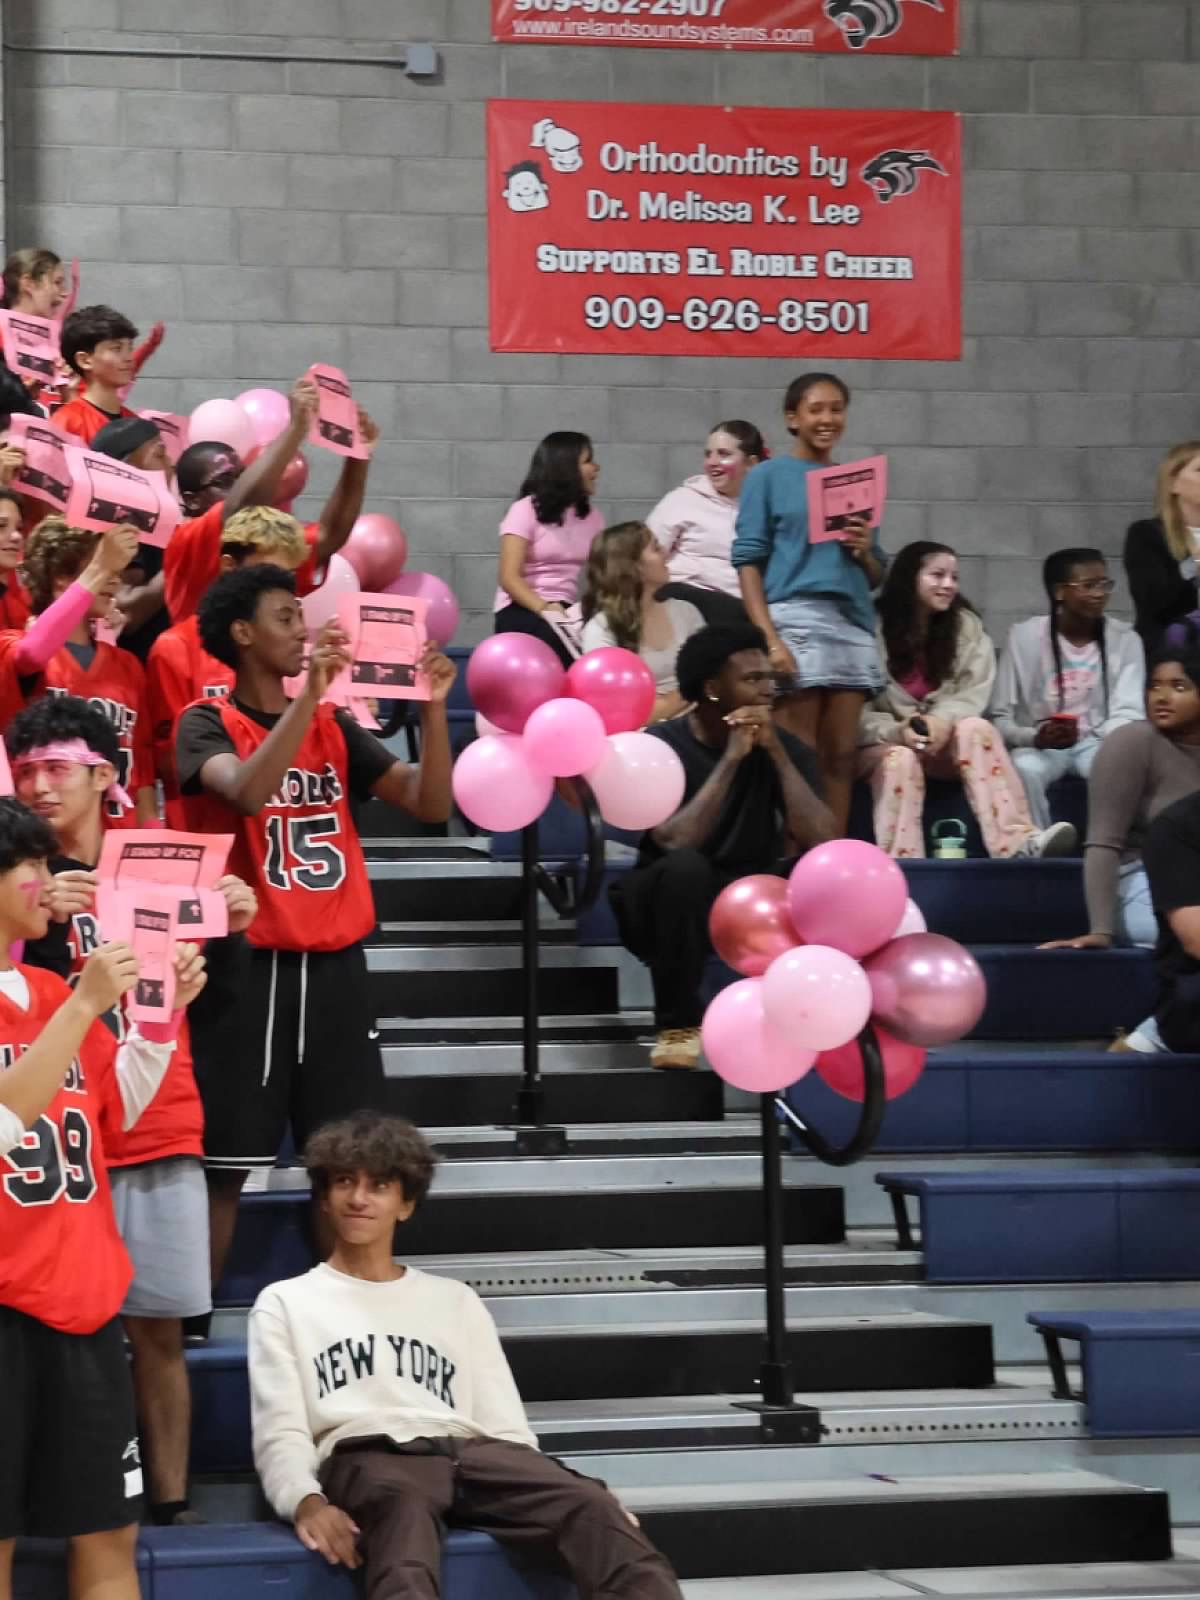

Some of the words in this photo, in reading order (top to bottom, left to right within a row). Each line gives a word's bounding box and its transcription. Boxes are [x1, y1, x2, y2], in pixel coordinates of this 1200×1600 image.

[513, 18, 814, 43] www.irelandsoundsystems.com
[600, 142, 799, 177] Orthodontics
[810, 145, 848, 187] by
[587, 190, 629, 221] Dr.
[640, 191, 753, 224] Melissa
[764, 195, 796, 223] K.
[809, 197, 860, 225] Lee
[537, 243, 680, 275] SUPPORTS
[731, 248, 818, 279] ROBLE
[825, 250, 912, 280] CHEER
[585, 296, 869, 333] 909-626-8501
[263, 812, 347, 891] 15
[3, 1107, 98, 1207] 99
[313, 1333, 375, 1399] NEW
[387, 1334, 456, 1410] YORK
